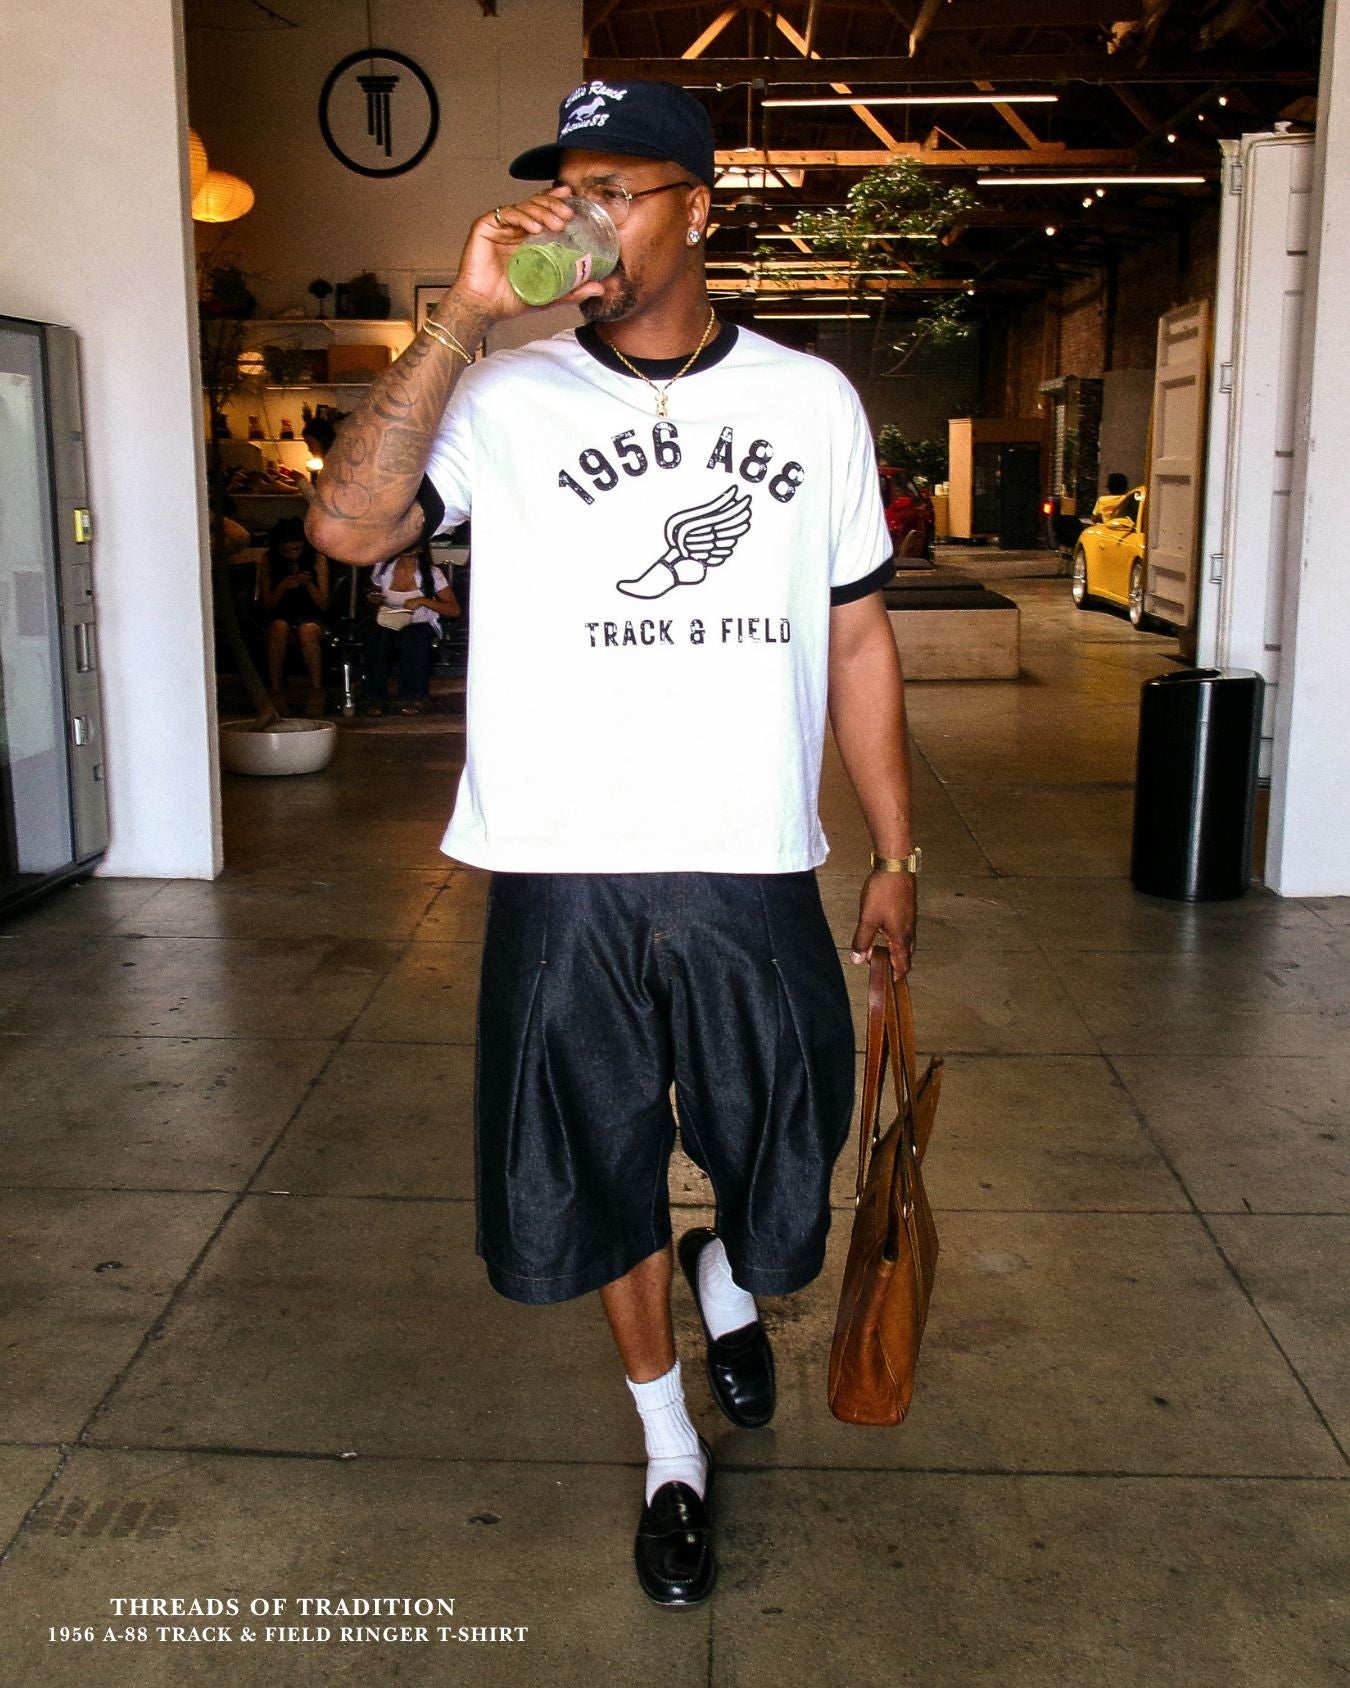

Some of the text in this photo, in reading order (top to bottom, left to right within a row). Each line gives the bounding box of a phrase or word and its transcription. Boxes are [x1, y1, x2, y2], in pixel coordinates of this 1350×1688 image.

[588, 80, 628, 101] Ranch
[558, 421, 806, 505] 1956 A88
[584, 617, 792, 647] TRACK & FIELD
